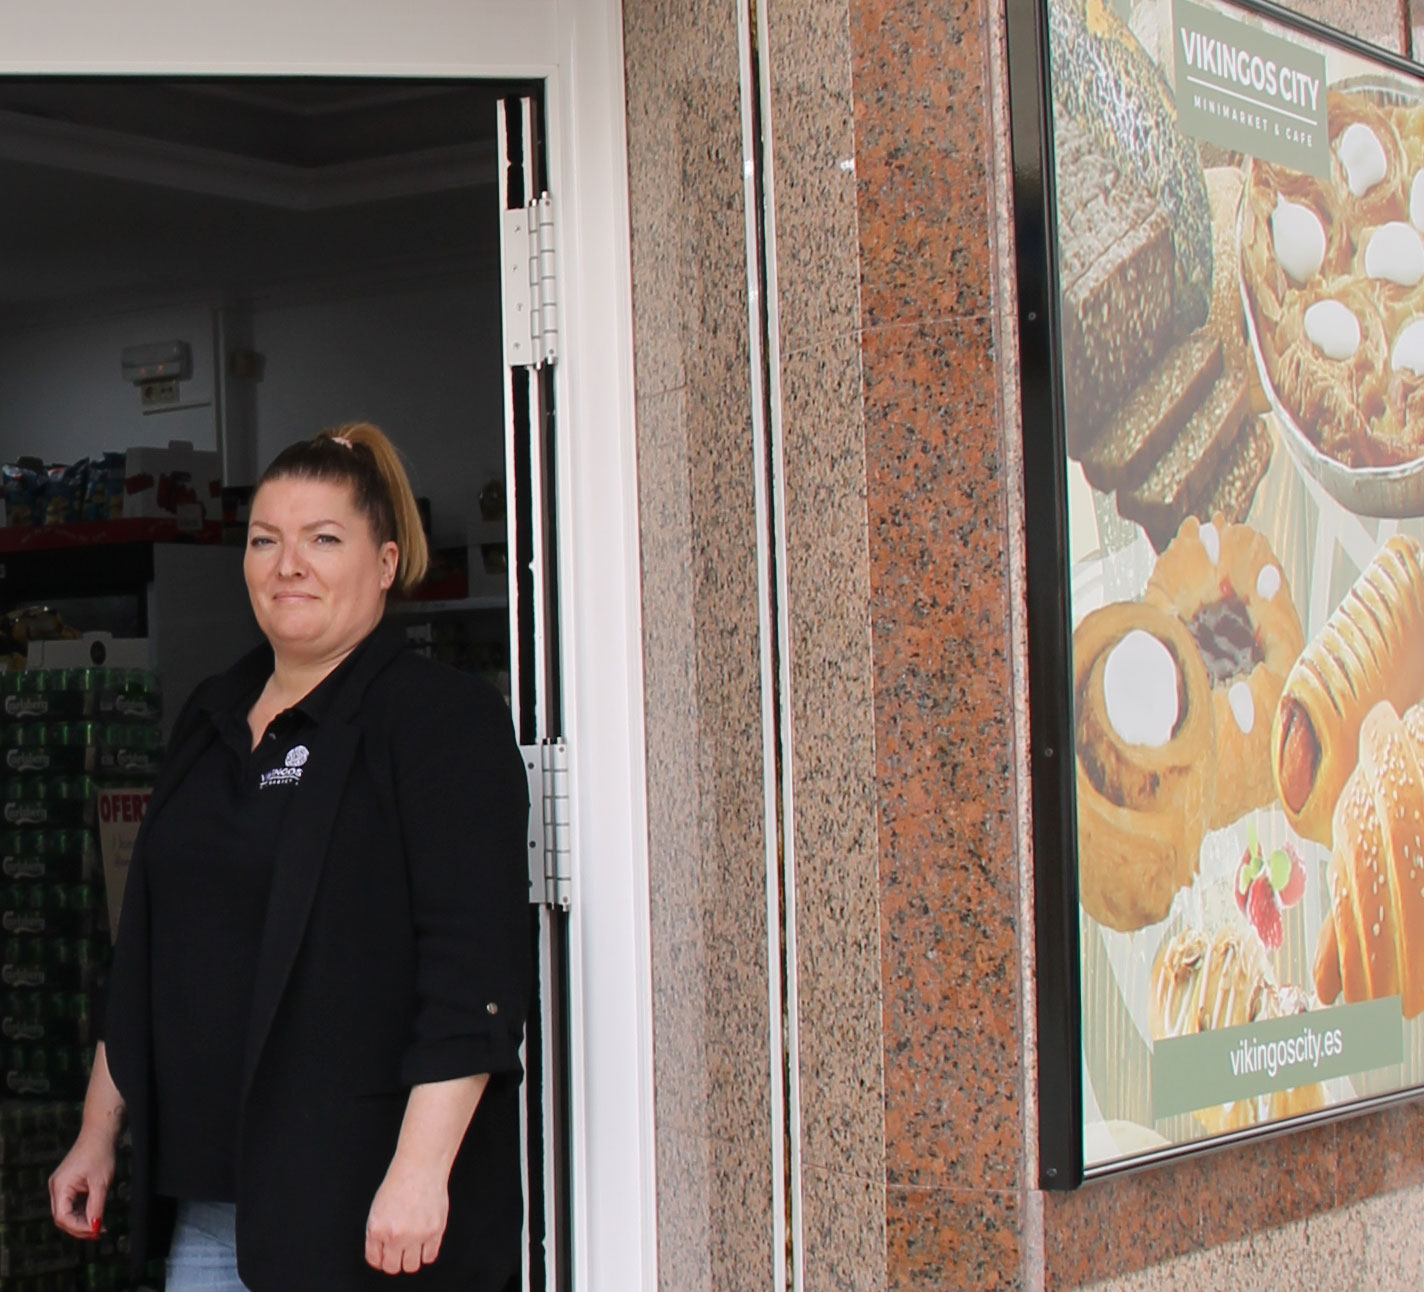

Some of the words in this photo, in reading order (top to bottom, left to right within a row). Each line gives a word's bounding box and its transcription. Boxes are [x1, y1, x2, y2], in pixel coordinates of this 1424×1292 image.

[1180, 27, 1277, 96] VIKINGOS
[1279, 67, 1319, 111] CITY
[1194, 95, 1268, 132] MINIMARKET
[1230, 1027, 1343, 1077] vikingoscity.es
